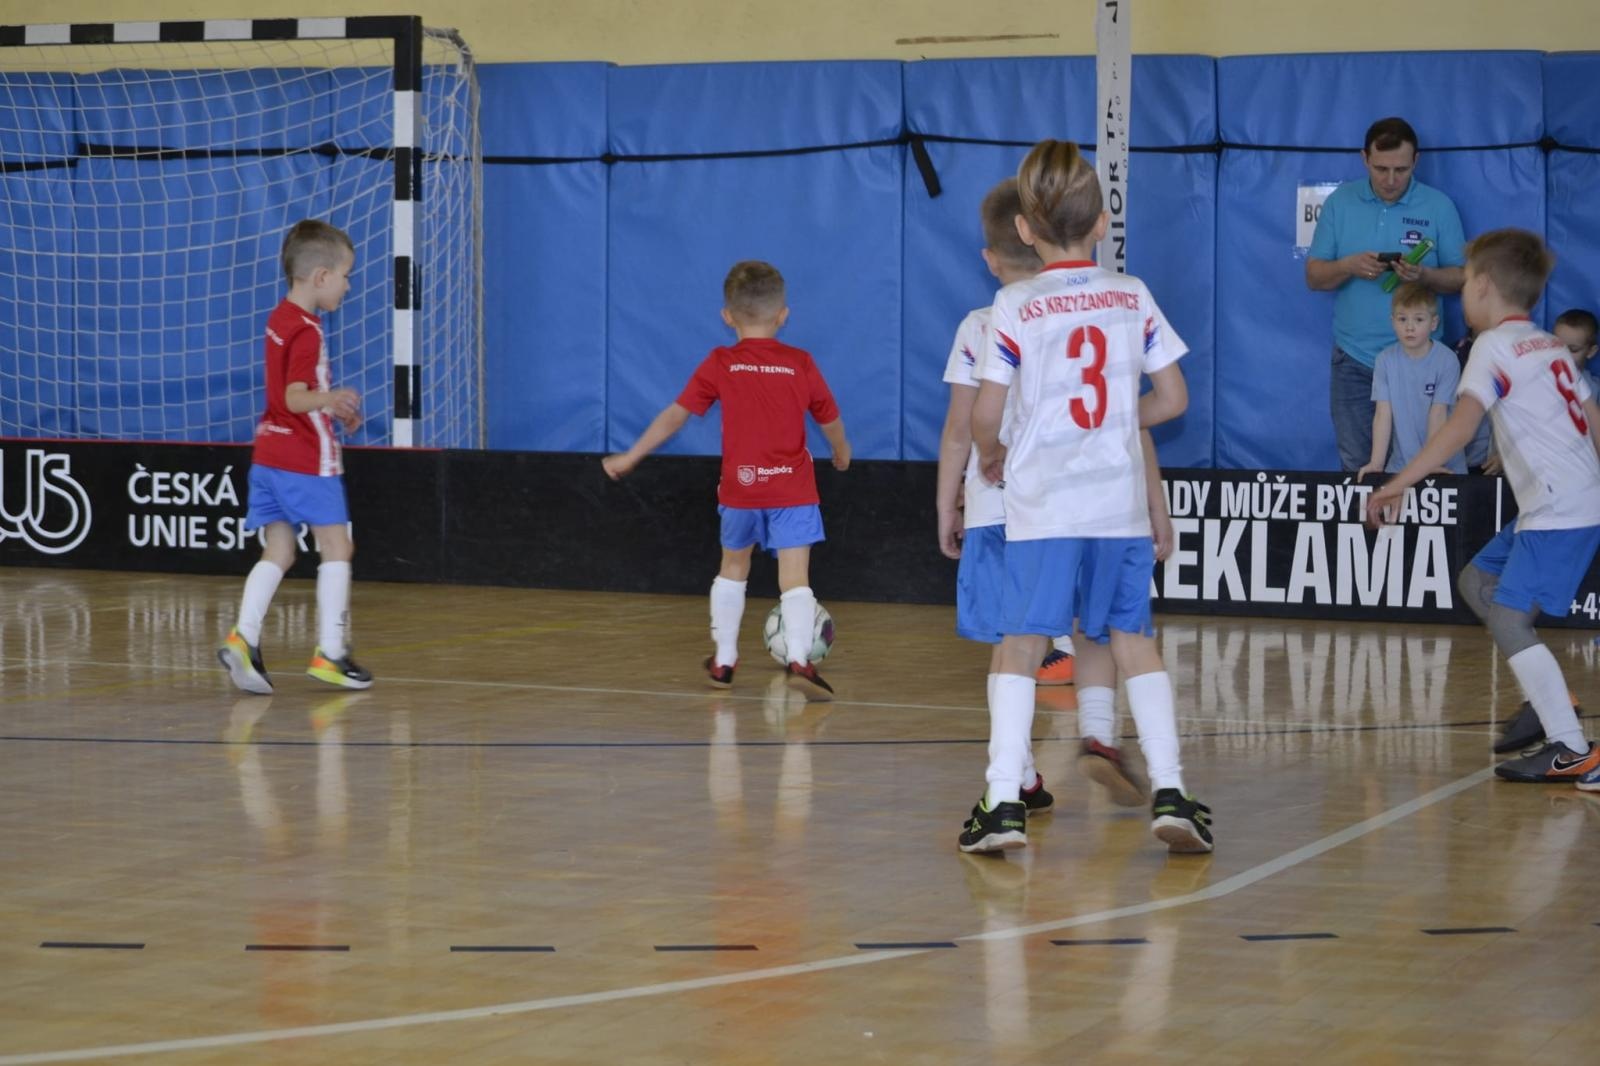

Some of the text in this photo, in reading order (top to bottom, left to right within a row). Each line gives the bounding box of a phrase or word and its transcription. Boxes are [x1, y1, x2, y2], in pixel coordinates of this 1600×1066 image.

[1109, 160, 1125, 274] NIOR
[1045, 290, 1139, 314] KRZYŻANOWICE
[729, 364, 795, 375] JUNIOR TRENING
[1066, 325, 1107, 430] 3
[0, 448, 92, 554] US
[127, 463, 239, 506] ČESKÁ
[1220, 472, 1306, 520] MŮŽE
[1316, 477, 1373, 522] BÝT
[128, 514, 208, 548] UNIE
[1152, 518, 1453, 609] EKLAMA
[1570, 592, 1600, 621] +4
